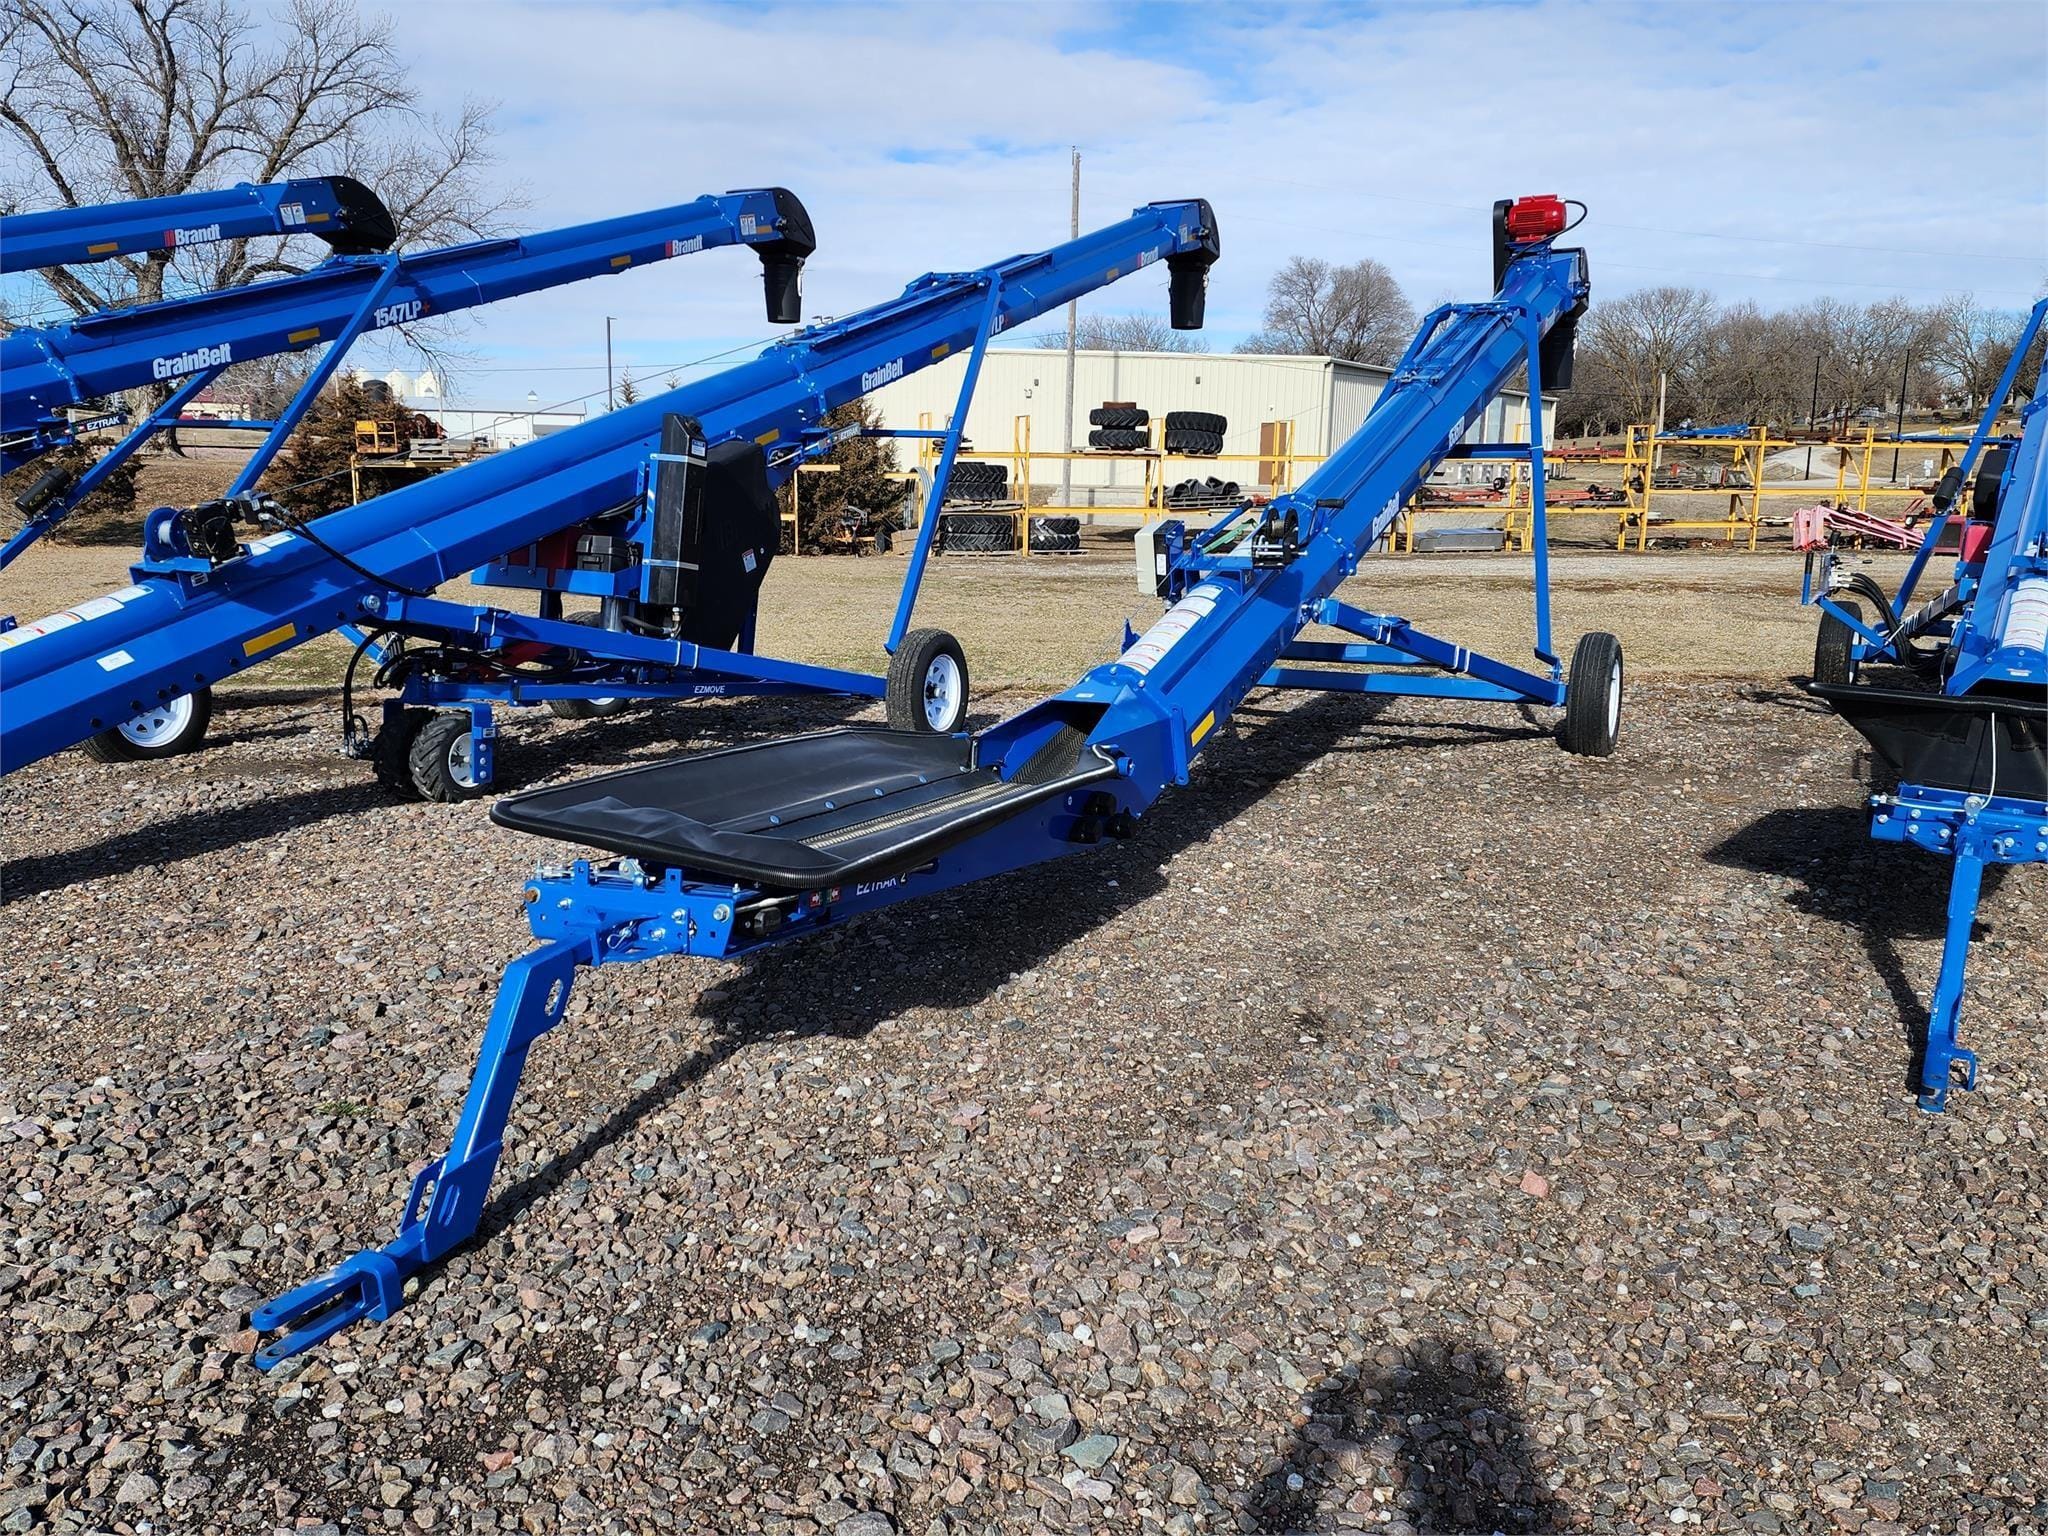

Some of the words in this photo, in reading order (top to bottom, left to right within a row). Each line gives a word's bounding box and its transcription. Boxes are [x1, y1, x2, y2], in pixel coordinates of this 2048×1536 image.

[174, 223, 221, 246] Brandt
[672, 234, 703, 256] Brandt
[153, 342, 232, 380] GrainBelt
[861, 357, 904, 392] GrainBelt
[86, 416, 121, 431] EZTRAK
[694, 685, 726, 694] EZMOVE
